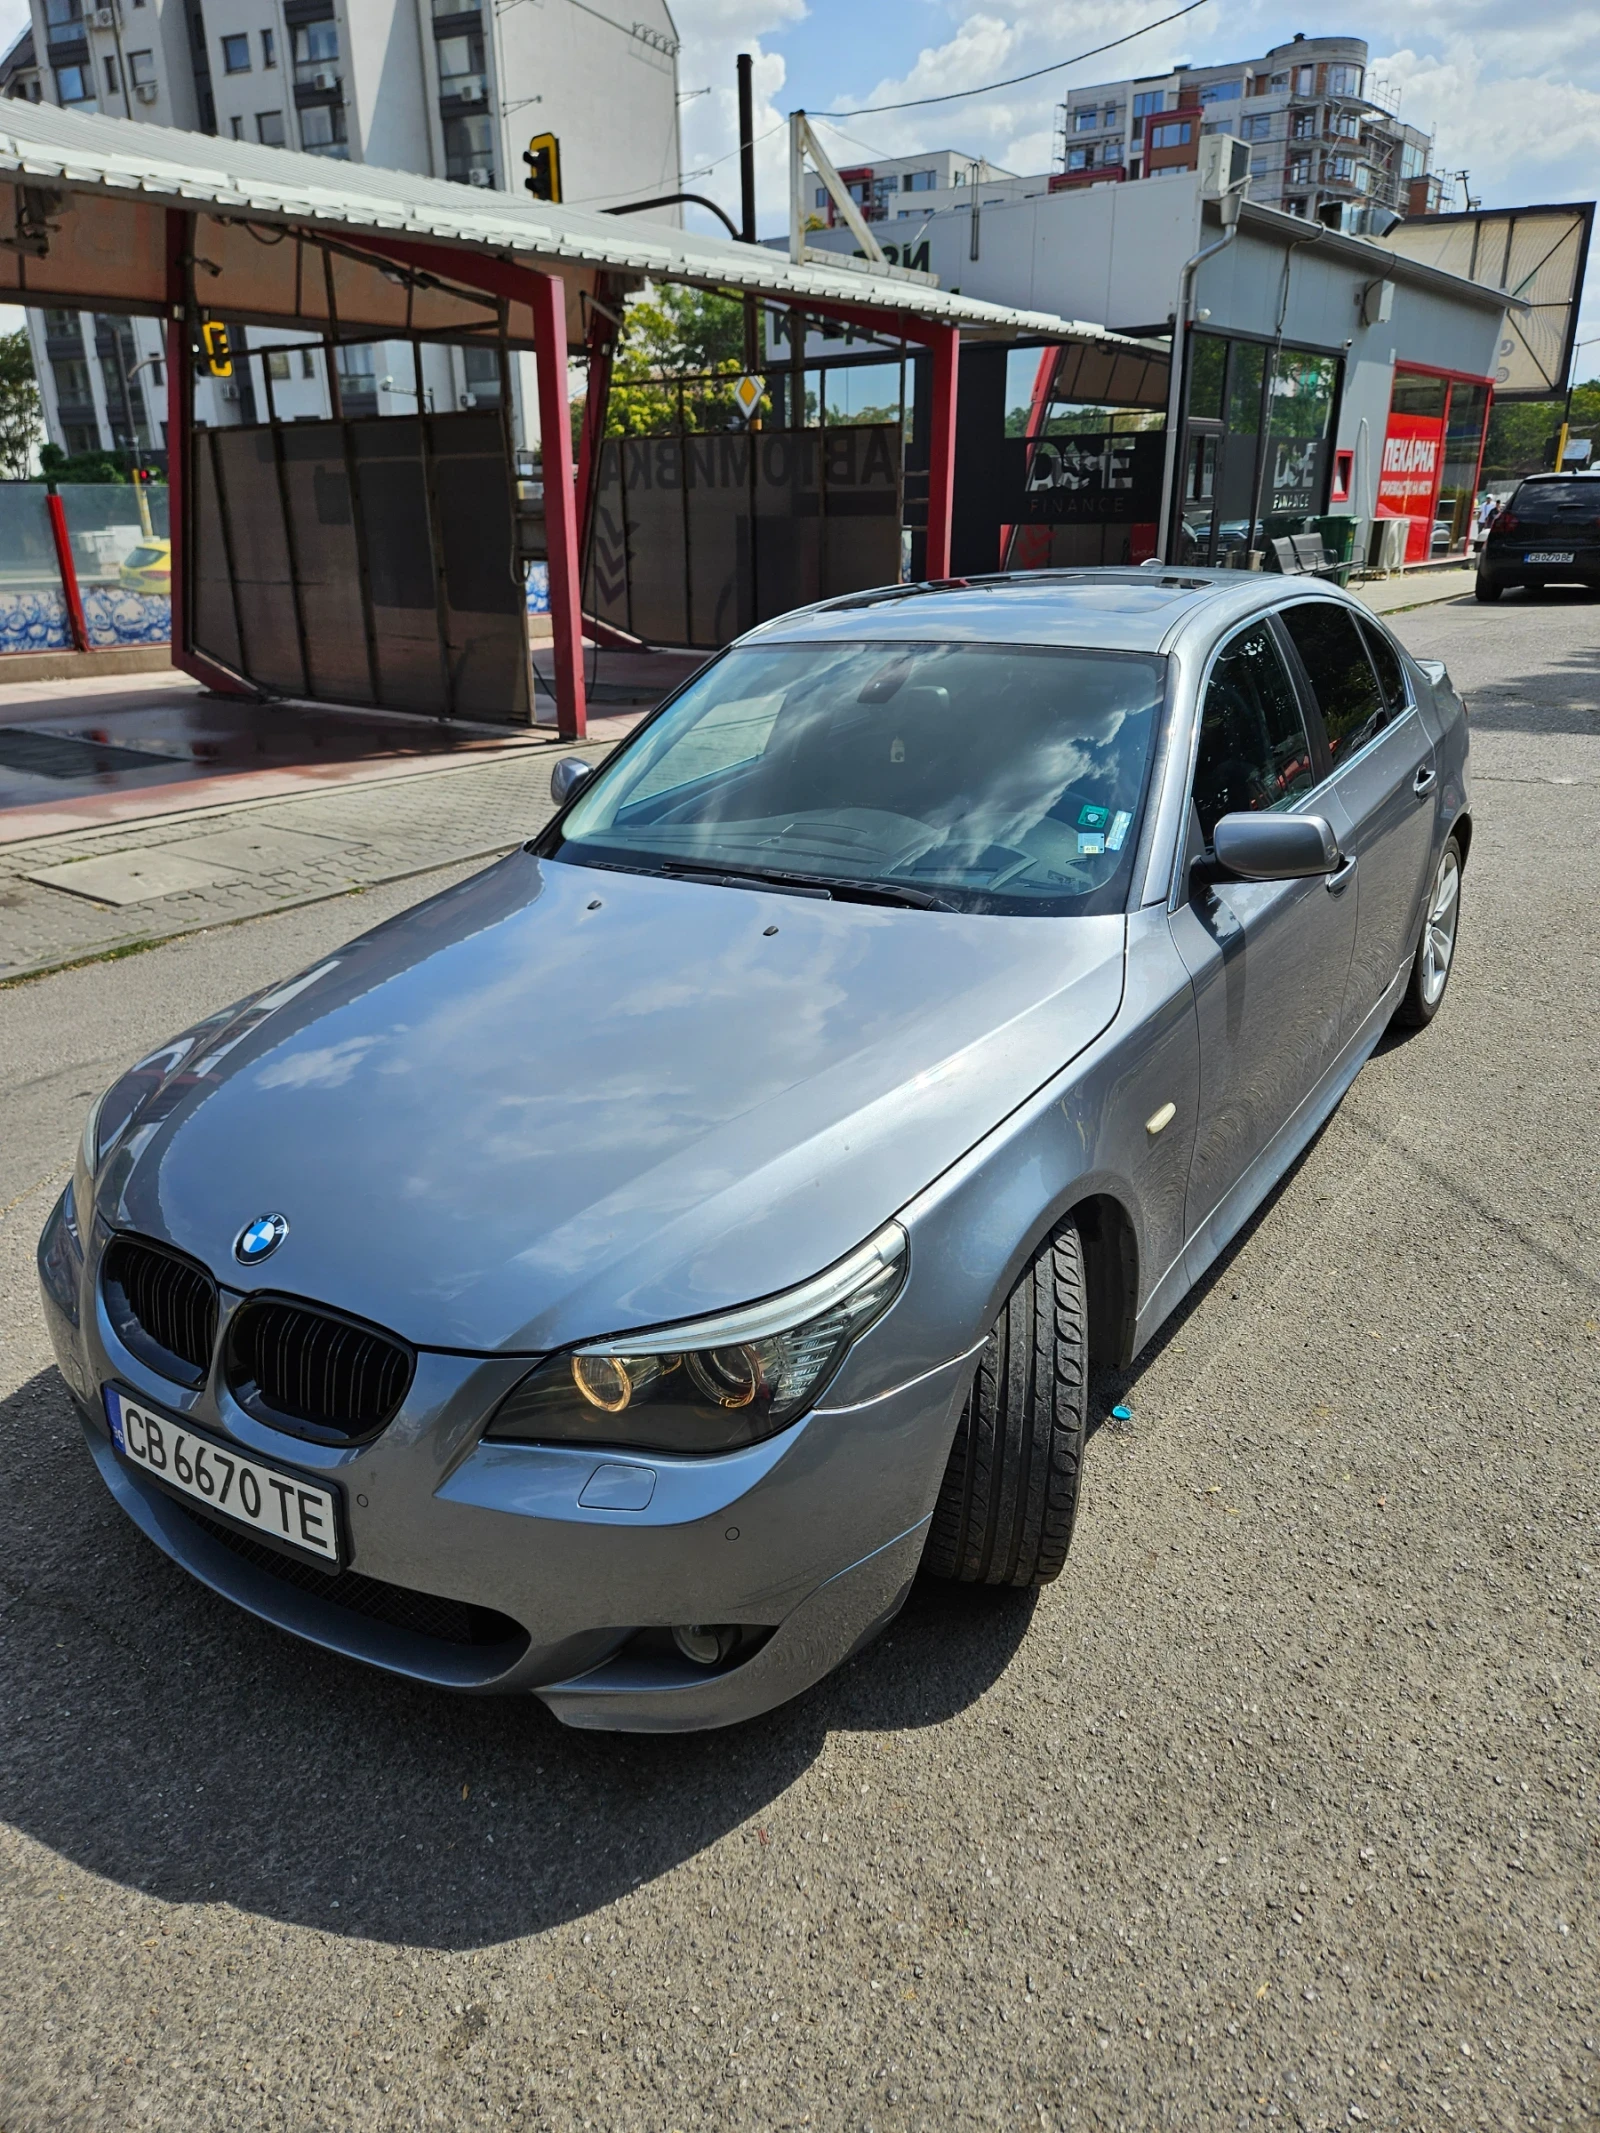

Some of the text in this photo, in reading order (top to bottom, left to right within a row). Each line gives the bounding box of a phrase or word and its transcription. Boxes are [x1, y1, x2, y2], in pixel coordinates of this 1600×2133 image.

[1382, 438, 1436, 472] ПЕКАРНА
[1030, 496, 1126, 514] FINANCE
[125, 1408, 328, 1549] CB 6670 TE
